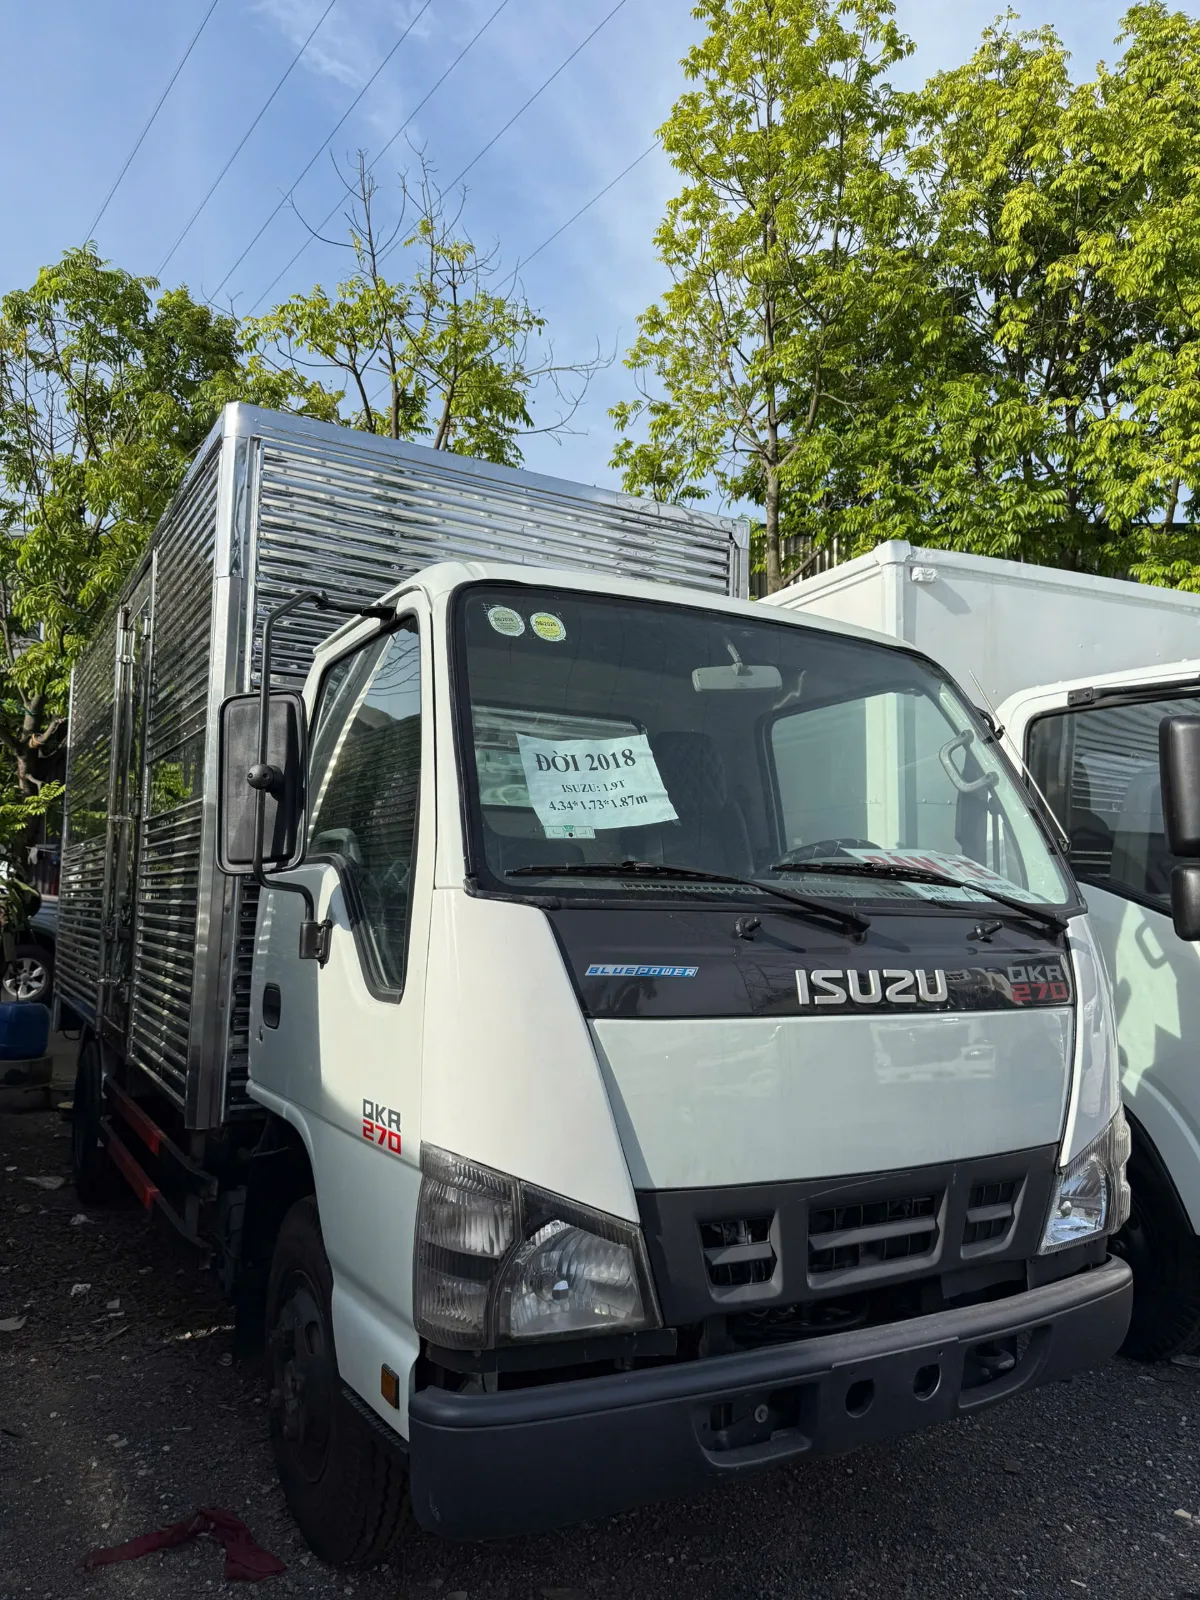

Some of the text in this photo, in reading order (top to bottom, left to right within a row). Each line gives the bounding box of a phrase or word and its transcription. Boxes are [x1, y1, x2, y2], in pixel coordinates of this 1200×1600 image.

[534, 748, 636, 772] ĐỜI 2018
[561, 780, 625, 793] ISUZU: 1.9T
[588, 965, 697, 977] BLUEPOWER
[1007, 965, 1064, 982] QKR
[795, 969, 948, 1004] ISUZU
[1010, 982, 1069, 1002] 270
[363, 1098, 401, 1133] QKR
[363, 1118, 401, 1155] 270
